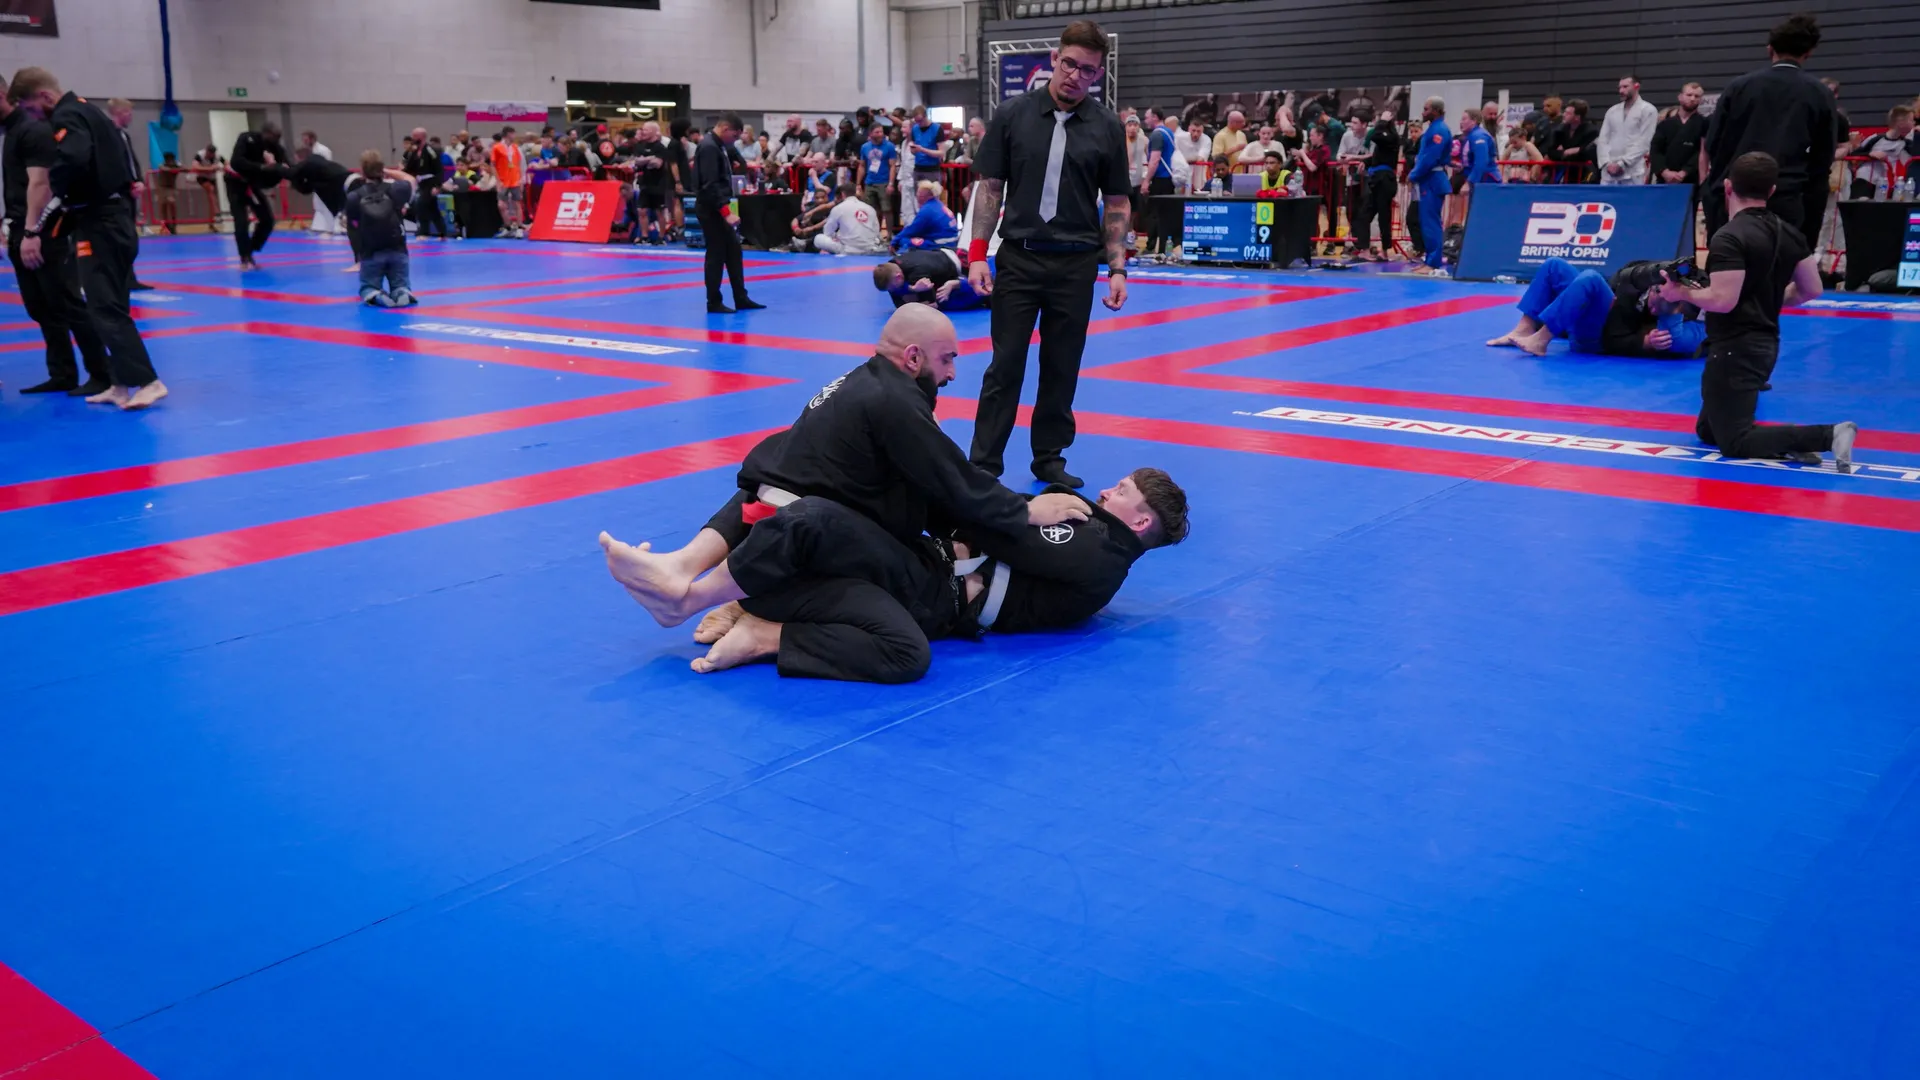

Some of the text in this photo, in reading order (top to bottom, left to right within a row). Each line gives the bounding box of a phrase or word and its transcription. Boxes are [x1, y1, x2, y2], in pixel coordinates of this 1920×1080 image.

[1260, 206, 1270, 221] 0
[1259, 226, 1270, 243] 9
[1243, 245, 1270, 260] 02:41
[1520, 245, 1609, 258] BRITISH OPEN
[1261, 410, 1625, 450] CONNECT
